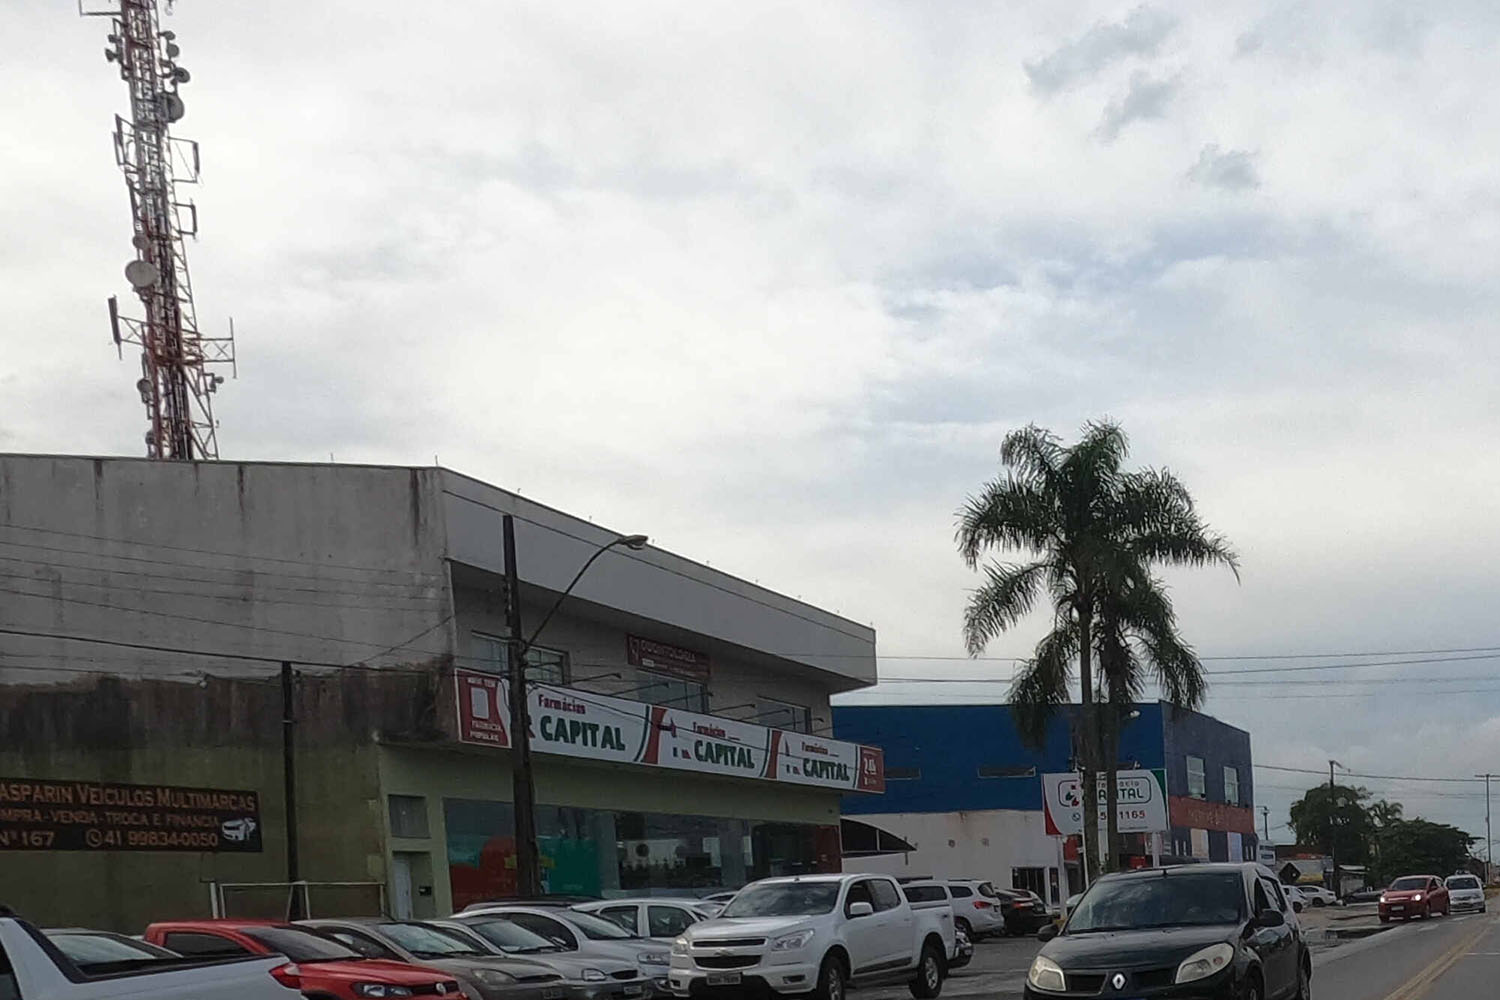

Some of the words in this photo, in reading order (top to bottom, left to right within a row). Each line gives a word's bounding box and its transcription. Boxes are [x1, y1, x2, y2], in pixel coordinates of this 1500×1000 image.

[540, 715, 626, 751] CAPITAL
[694, 740, 755, 768] CAPITAL
[803, 758, 850, 781] CAPITAL
[157, 787, 255, 812] MULTIMARCAS
[1092, 788, 1144, 800] ATAL
[22, 830, 55, 847] 167
[104, 830, 122, 847] 41
